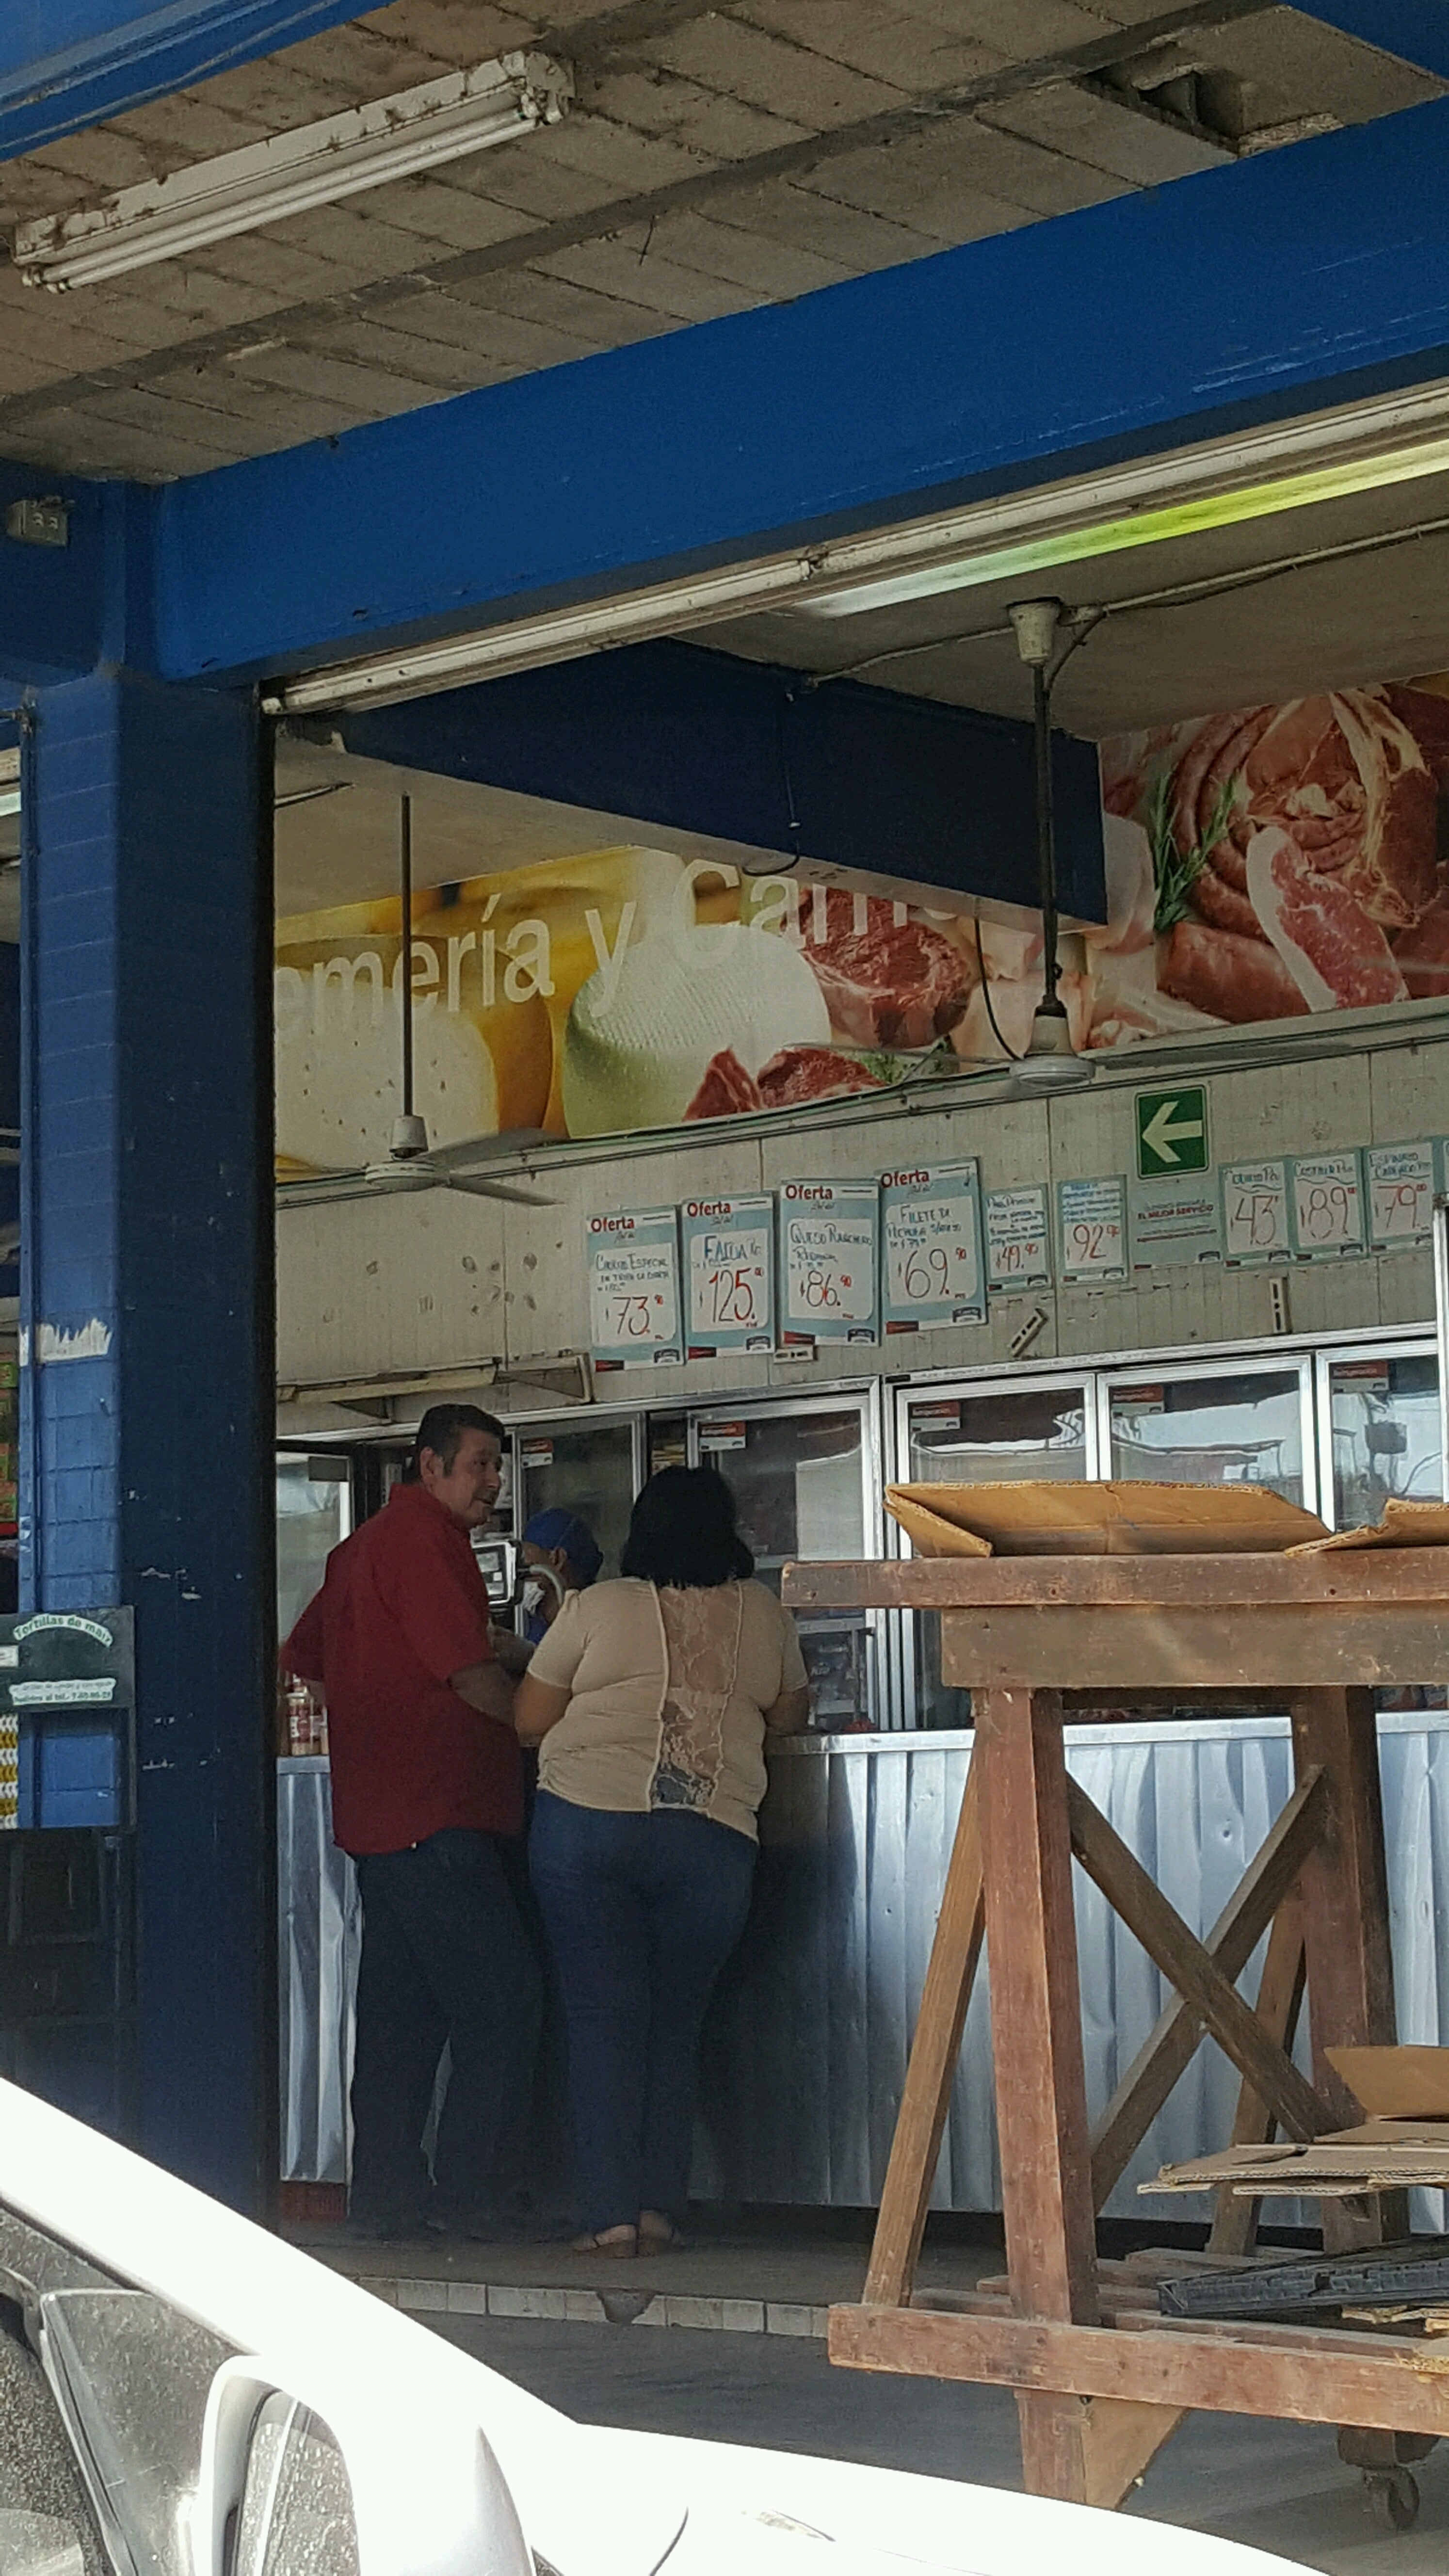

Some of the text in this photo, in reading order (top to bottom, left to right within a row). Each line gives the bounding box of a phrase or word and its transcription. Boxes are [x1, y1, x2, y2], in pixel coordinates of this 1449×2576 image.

[585, 900, 638, 1018] y
[881, 1169, 930, 1188] Oferta
[786, 1184, 833, 1200] Oferta
[688, 1201, 731, 1218] Oferta
[591, 1216, 634, 1233] Oferta
[15, 1615, 63, 1639] Tortillas
[67, 1616, 82, 1627] de
